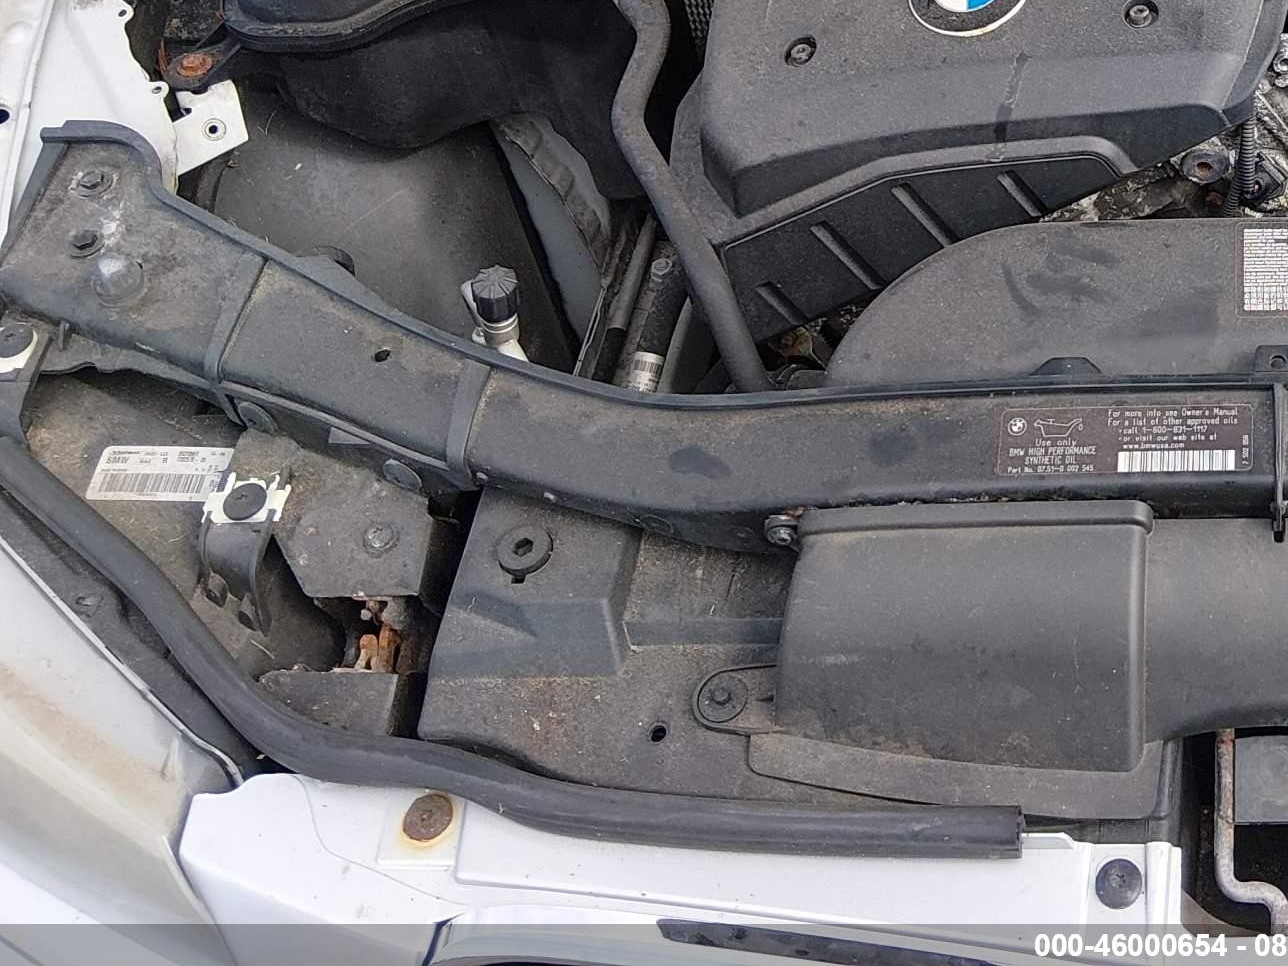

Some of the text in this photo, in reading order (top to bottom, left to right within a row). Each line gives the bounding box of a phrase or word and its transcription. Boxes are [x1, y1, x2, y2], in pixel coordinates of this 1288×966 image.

[1108, 408, 1120, 418] For
[1146, 408, 1161, 417] info
[1181, 407, 1209, 416] Owner's
[1213, 406, 1238, 416] Manual
[1107, 417, 1120, 427] For
[1133, 417, 1146, 426] list
[1150, 417, 1159, 425] of
[1163, 417, 1183, 426] other
[1186, 415, 1219, 426] approved
[1223, 415, 1238, 424] oils
[1035, 437, 1077, 447] Use only
[1135, 434, 1152, 442] visit
[1123, 441, 1185, 450] www.bmwusa.com
[1009, 445, 1097, 457] BMW HIGH PERFORMANCE
[1024, 455, 1077, 465] SYNTHETIC OIL
[1007, 466, 1021, 474] Part
